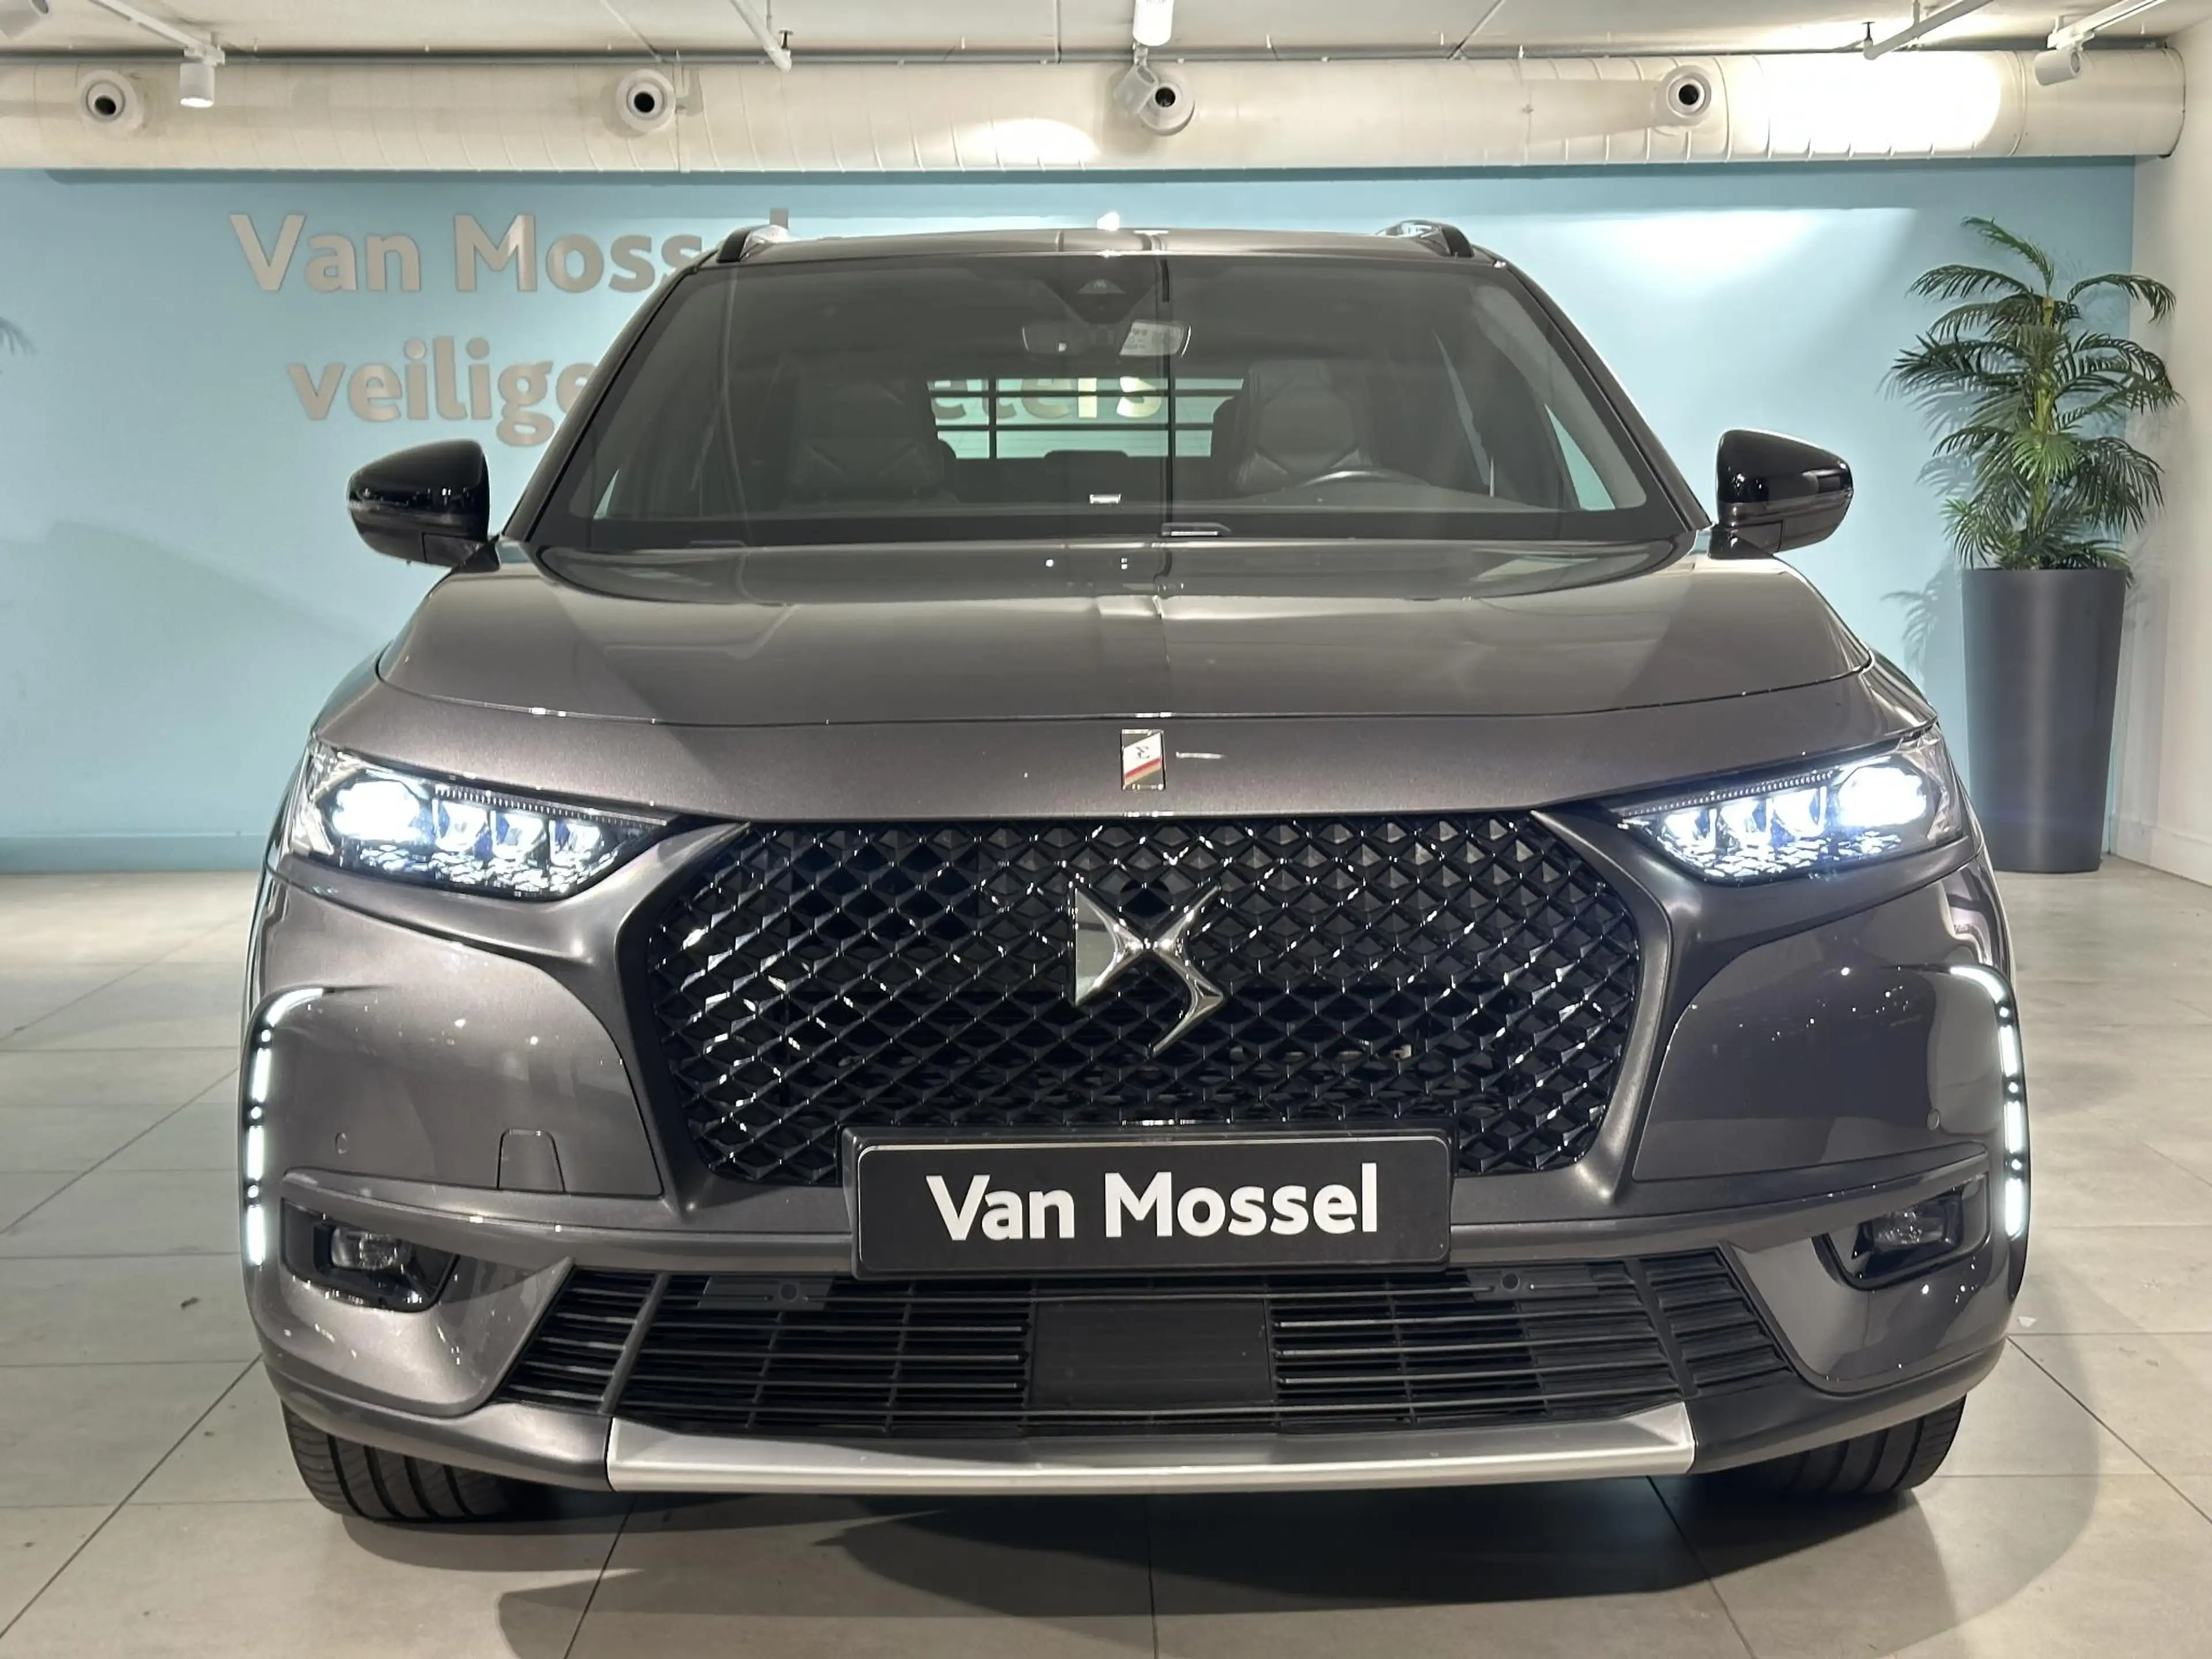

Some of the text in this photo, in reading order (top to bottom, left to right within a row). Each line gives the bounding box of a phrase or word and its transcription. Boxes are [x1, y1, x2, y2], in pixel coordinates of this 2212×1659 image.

[229, 207, 789, 293] Van Moss
[926, 1162, 1378, 1241] Van Mossel
